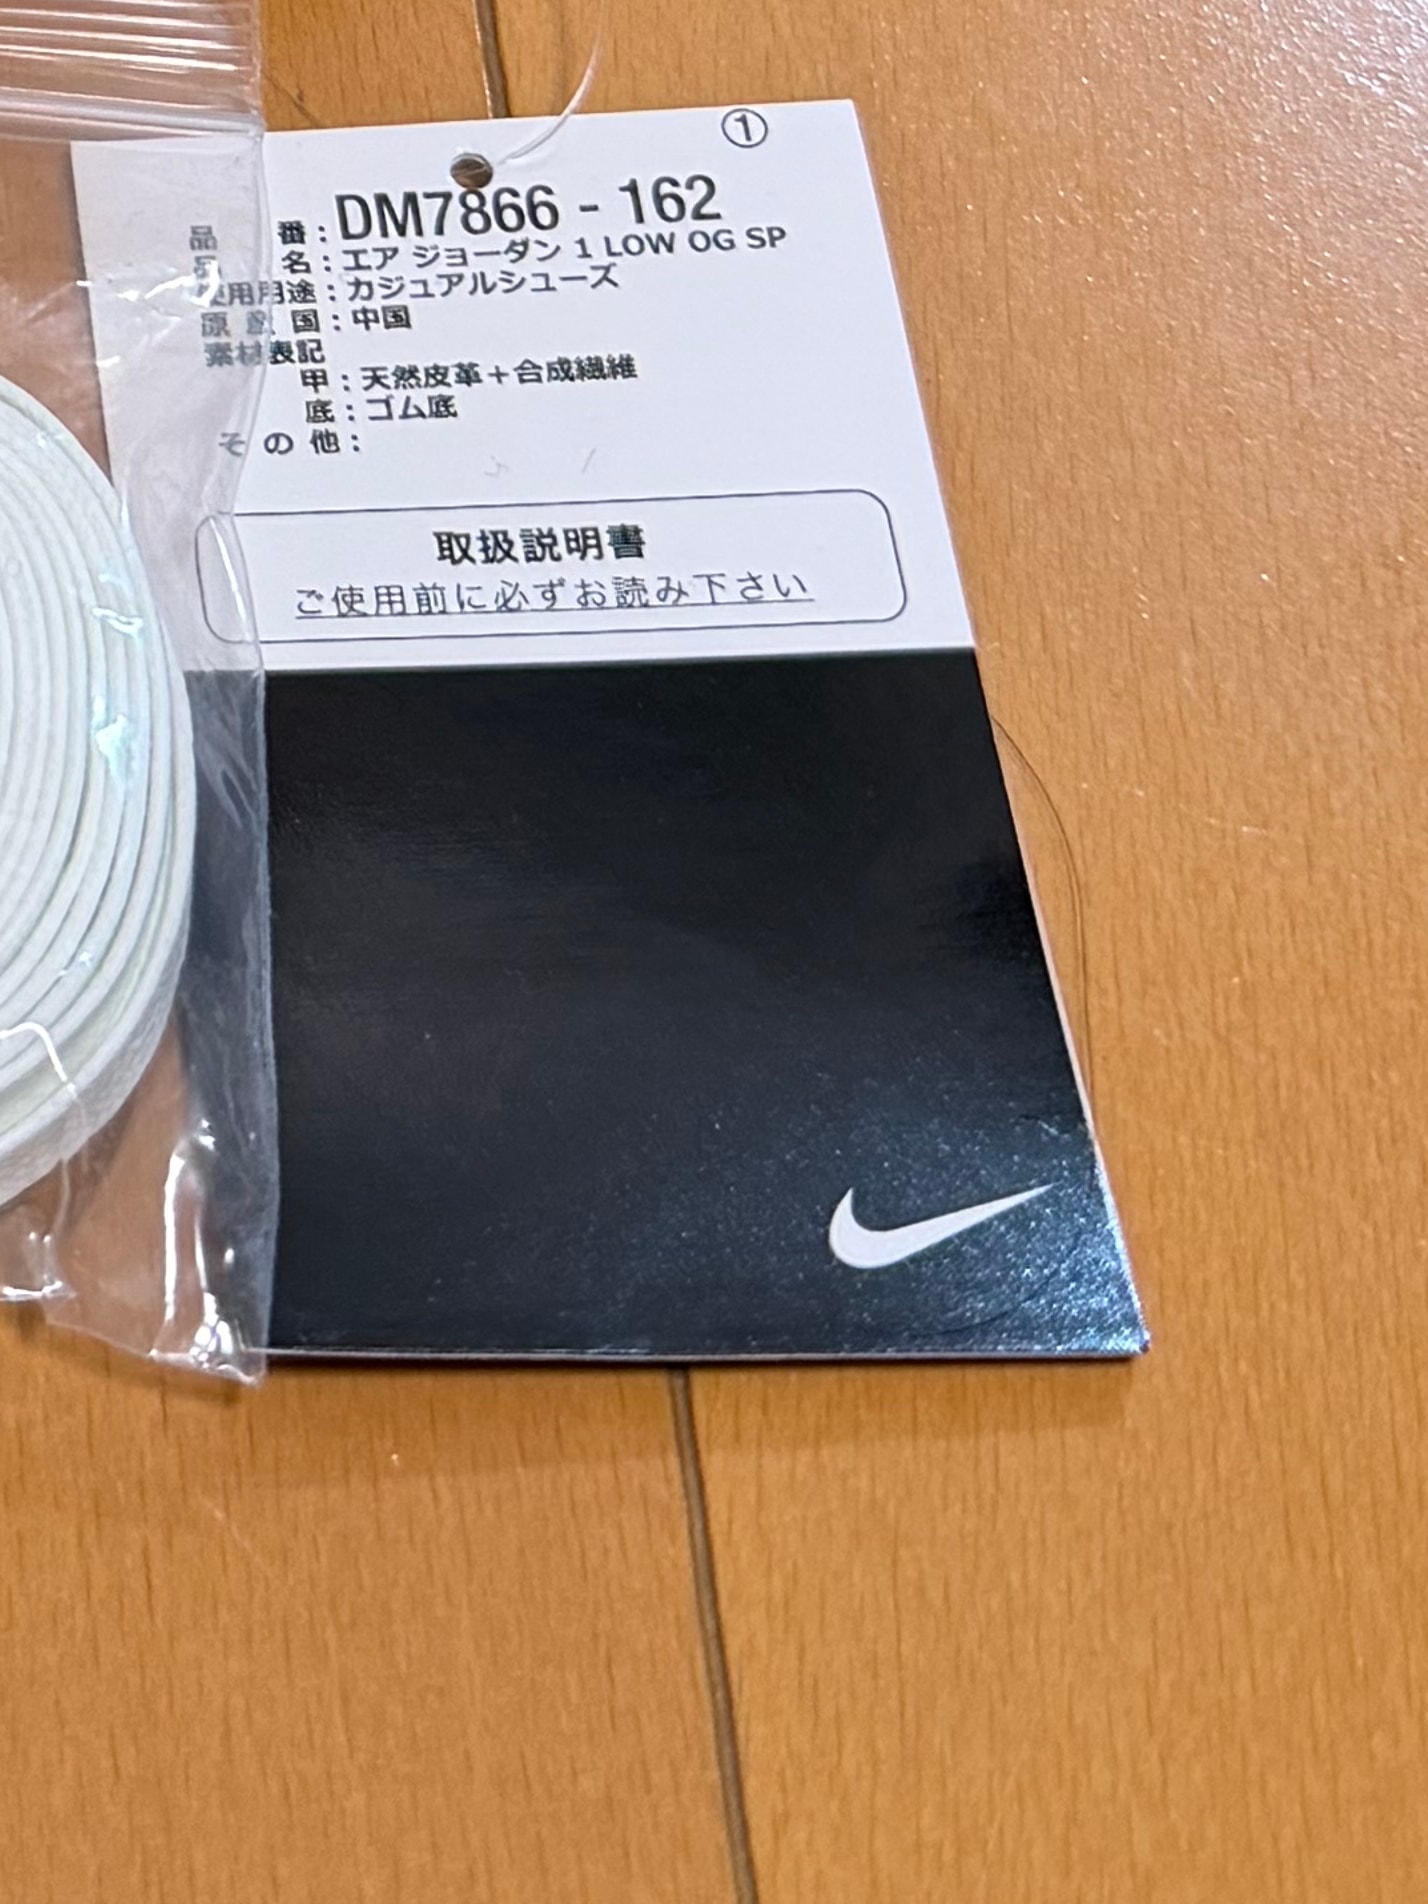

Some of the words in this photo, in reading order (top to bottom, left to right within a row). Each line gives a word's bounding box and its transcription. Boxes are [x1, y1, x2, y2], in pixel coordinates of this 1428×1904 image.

[335, 185, 560, 241] DM7866
[617, 174, 722, 225] 162
[603, 231, 677, 258] LOW
[687, 229, 736, 254] OG
[746, 226, 787, 250] SP
[351, 305, 412, 332] 中国
[365, 393, 459, 422] ゴム底
[432, 523, 647, 565] 取扱説明書
[295, 571, 810, 617] ご使用前に必ずお読み下さい
